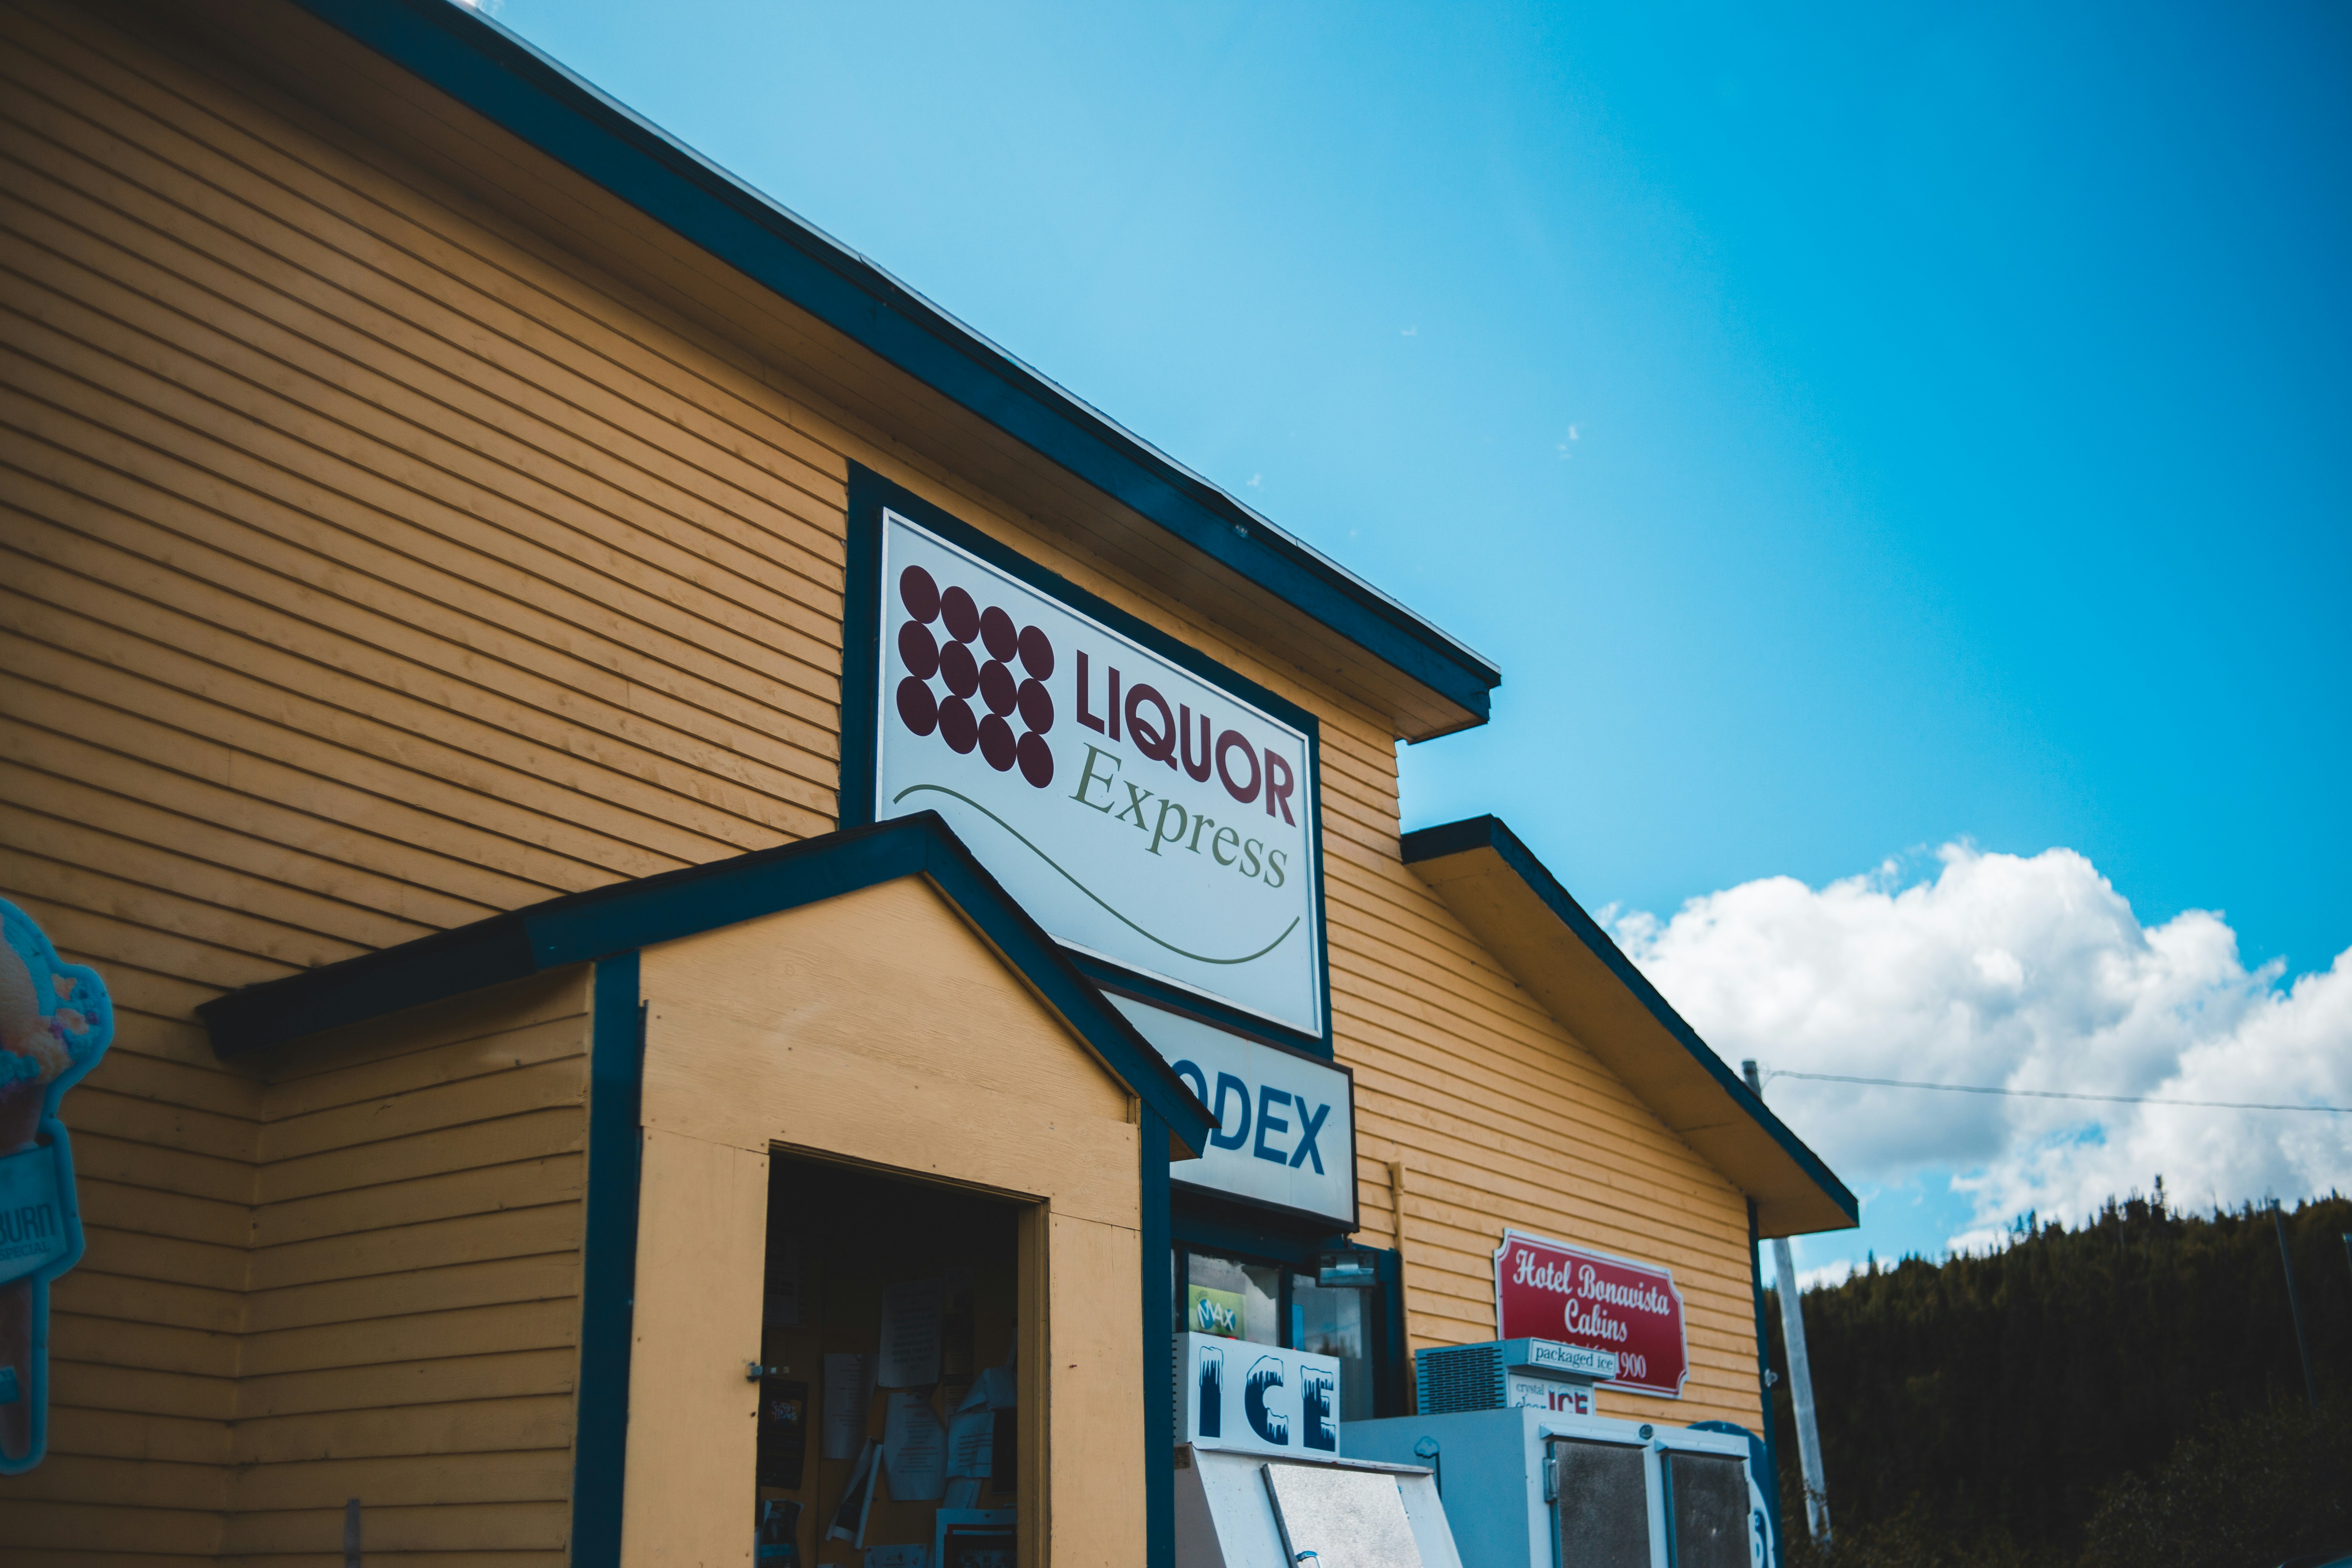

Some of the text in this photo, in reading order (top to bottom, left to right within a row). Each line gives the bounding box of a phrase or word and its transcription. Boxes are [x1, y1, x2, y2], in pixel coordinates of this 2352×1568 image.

[1077, 649, 1296, 828] LIQUOR
[1068, 743, 1287, 888] Express
[1513, 1249, 1671, 1316] Hotel Bonavista
[1197, 1300, 1234, 1331] MAX
[1565, 1298, 1628, 1342] Cabins
[1536, 1347, 1612, 1370] packaged ice
[1199, 1346, 1336, 1452] ICE
[1516, 1384, 1544, 1396] crystal
[1549, 1384, 1588, 1415] ICE
